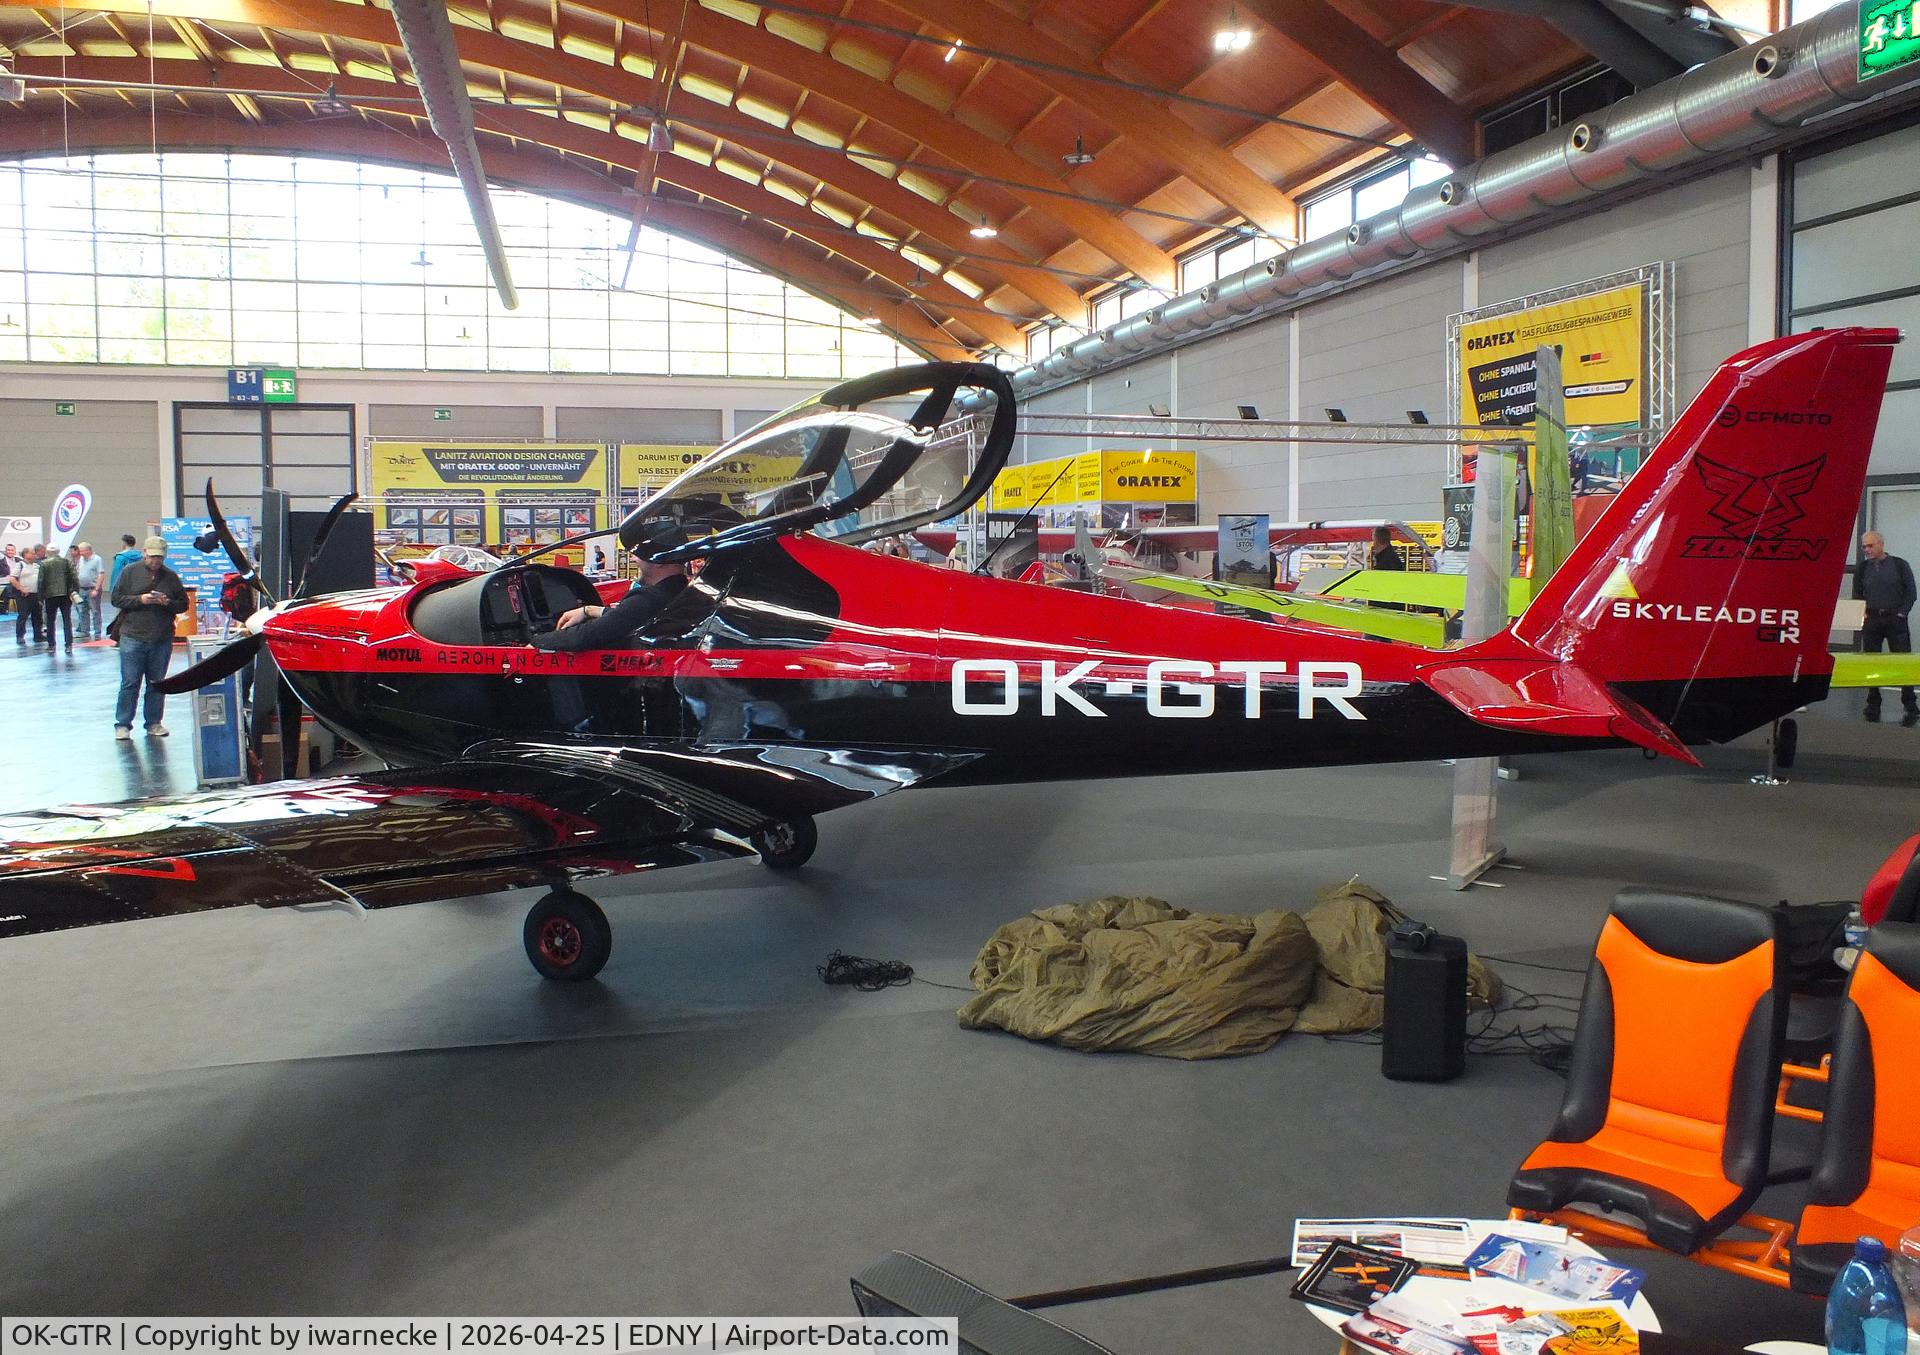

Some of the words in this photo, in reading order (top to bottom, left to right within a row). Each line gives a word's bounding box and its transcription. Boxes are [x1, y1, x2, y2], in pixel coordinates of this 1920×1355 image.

[1467, 331, 1515, 350] ORATEX
[1521, 328, 1535, 338] DAS
[236, 371, 256, 384] B1
[1478, 368, 1500, 382] OHNE
[1478, 389, 1500, 403] OHNE
[1480, 410, 1501, 423] OHNE
[1745, 411, 1831, 425] CFMOTO
[435, 452, 467, 460] LANITZ
[469, 452, 512, 460] AVIATION
[513, 452, 547, 460] DESIGN
[548, 452, 586, 460] CHANGE
[527, 473, 563, 481] ÄNDERUNG
[1117, 475, 1181, 487] ORATEX
[1612, 602, 1799, 626] SKYLEADER
[376, 648, 422, 662] MOTUL
[437, 650, 575, 668] AEROHANGAR
[617, 656, 663, 665] HELIX
[951, 659, 1368, 721] OK-GTR
